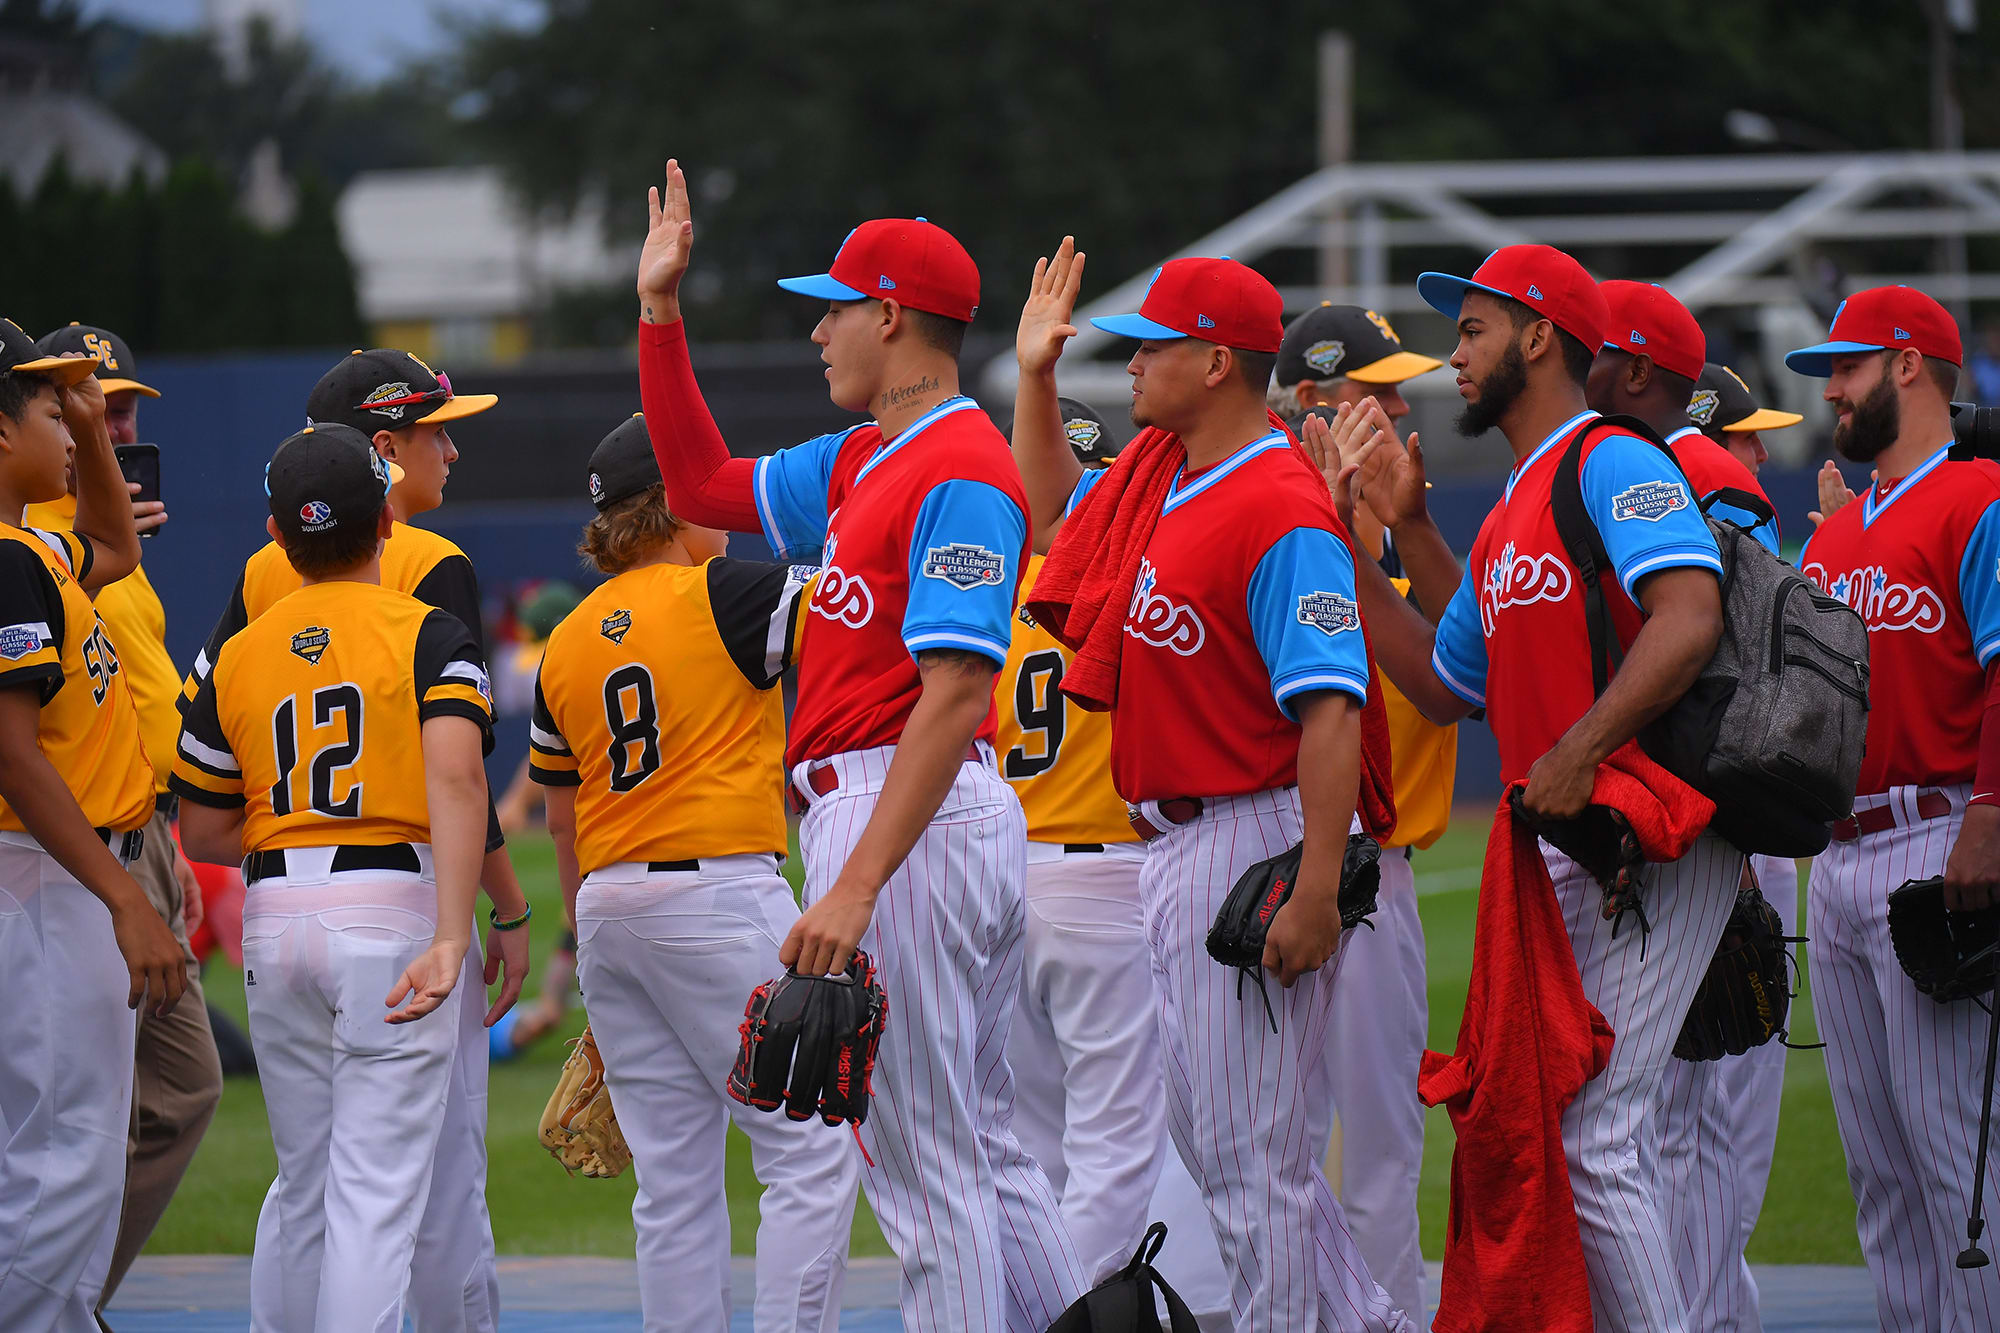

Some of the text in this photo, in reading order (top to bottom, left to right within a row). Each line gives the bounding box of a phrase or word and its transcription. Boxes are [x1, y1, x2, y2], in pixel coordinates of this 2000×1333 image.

[83, 333, 119, 370] SE
[1618, 489, 1680, 507] LITTLE LEAGUE
[1635, 499, 1667, 511] CLASSIC
[301, 519, 338, 532] SOUTHEAST
[933, 554, 999, 569] LITTLE LEAGUE
[948, 565, 982, 575] CLASSIC
[1303, 602, 1354, 615] LITTLE LEAGUE
[1316, 612, 1343, 624] CLASSIC
[11, 633, 37, 642] LEAGUE
[1, 641, 26, 650] CLASSIC
[1003, 647, 1066, 782] 9
[603, 661, 662, 794] 8
[270, 681, 364, 820] 12
[1259, 879, 1288, 926] ALL-STAR
[837, 1046, 853, 1100] ALL-STAR
